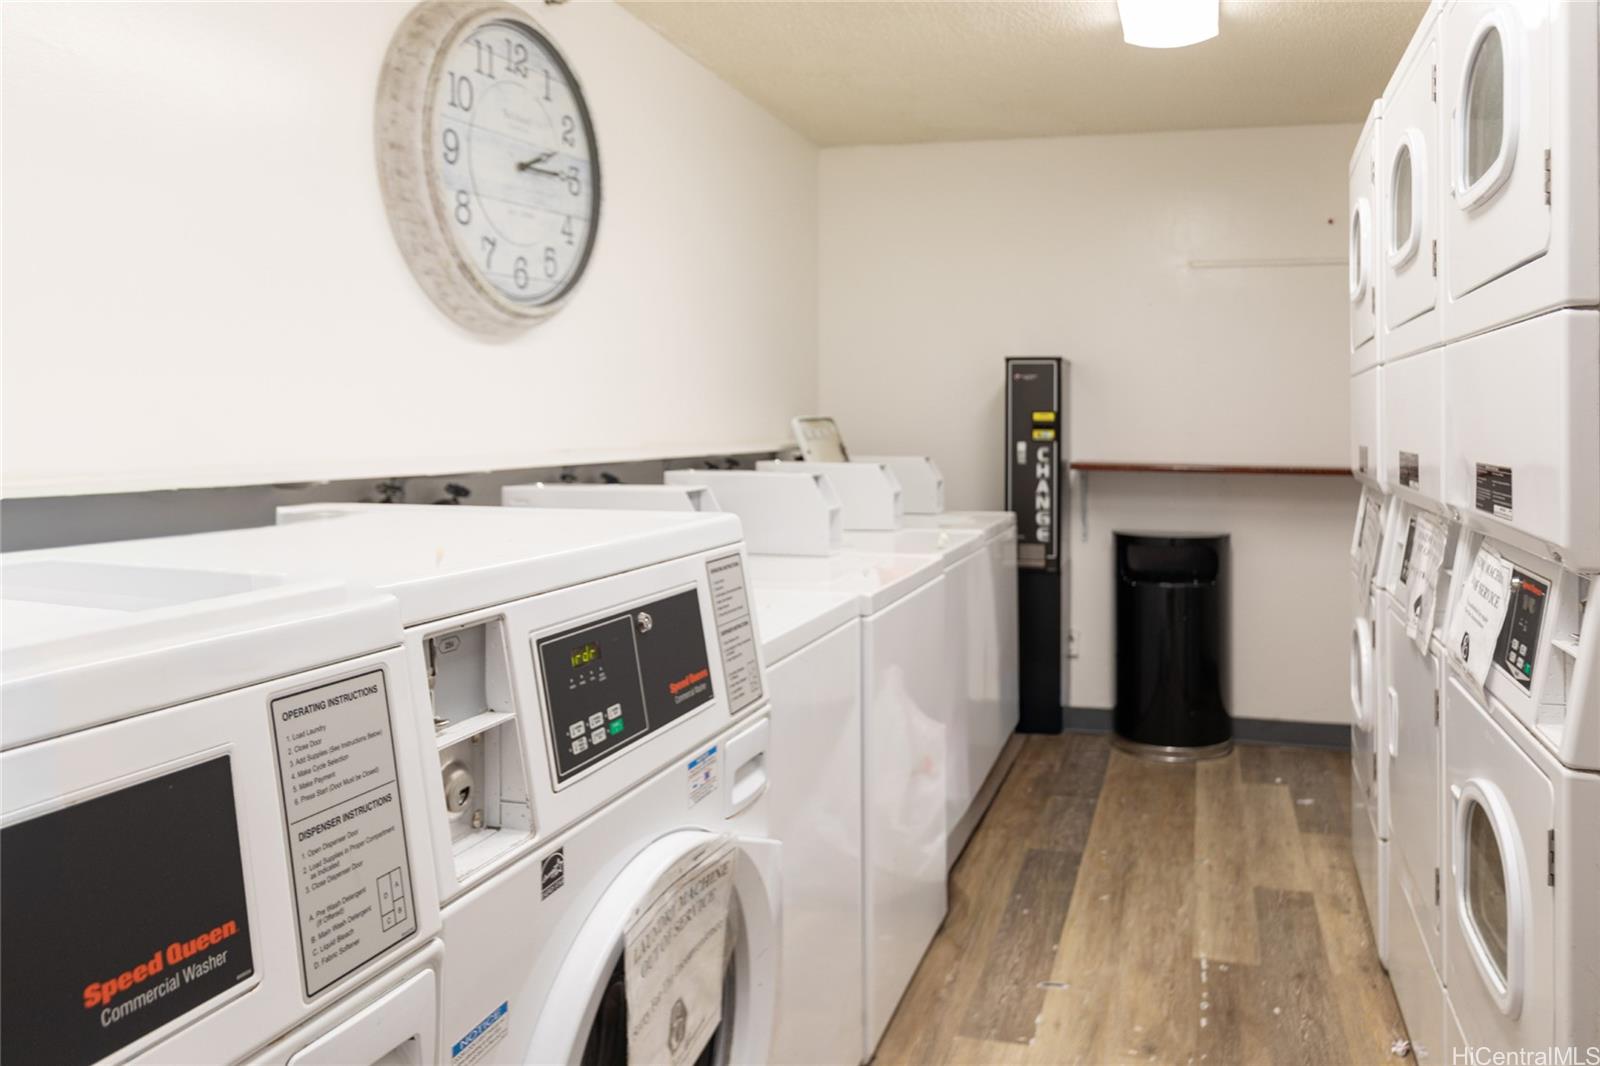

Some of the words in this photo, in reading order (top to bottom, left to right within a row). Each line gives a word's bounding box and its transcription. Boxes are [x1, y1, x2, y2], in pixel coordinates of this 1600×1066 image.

[474, 40, 495, 79] 11
[505, 39, 529, 79] 12
[448, 71, 474, 112] 10
[543, 69, 552, 102] 1
[443, 128, 460, 165] 9
[561, 115, 575, 147] 2
[568, 166, 581, 196] 3
[455, 190, 472, 225] 8
[561, 216, 574, 246] 4
[481, 236, 496, 270] 7
[544, 247, 558, 279] 5
[513, 256, 529, 289] 6
[1035, 447, 1051, 543] CHANGE
[282, 700, 327, 721] OPERATING
[327, 685, 378, 707] INSTRUCTIONS
[292, 731, 305, 741] Load
[306, 725, 326, 737] Laundry
[294, 744, 309, 753] Close
[309, 739, 322, 748] Door
[296, 757, 306, 765] Add
[307, 750, 328, 761] Supplies
[341, 736, 367, 748] Instructions
[297, 769, 311, 777] Make
[312, 763, 326, 772] Cycle
[327, 754, 349, 766] Selection
[299, 781, 313, 790] Make
[314, 772, 336, 785] Payment
[301, 793, 315, 802] Press
[316, 787, 328, 797] Start
[343, 777, 354, 786] Must
[298, 816, 342, 842] DISPENSER
[342, 793, 392, 822] INSTRUCTIONS
[307, 847, 321, 857] Open
[322, 836, 346, 850] Dispenser
[347, 830, 358, 839] Door
[309, 860, 321, 871] Load
[323, 851, 343, 865] Supplies
[350, 841, 365, 853] Proper
[311, 880, 326, 890] Close
[327, 867, 350, 883] Dispenser
[352, 860, 363, 870] Door
[318, 860, 340, 876] Indicated
[327, 901, 341, 912] Wash
[342, 887, 366, 904] Detergent
[318, 929, 331, 939] Main
[332, 920, 346, 931] Wash
[348, 905, 372, 923] Detergent
[320, 939, 336, 952] Liquid
[337, 928, 354, 943] Bleach
[321, 951, 338, 965] Fabric
[339, 939, 360, 955] Softener
[83, 950, 164, 1009] Speed
[166, 919, 237, 966] Queen
[100, 972, 180, 1028] Commercial
[182, 950, 228, 984] Washer
